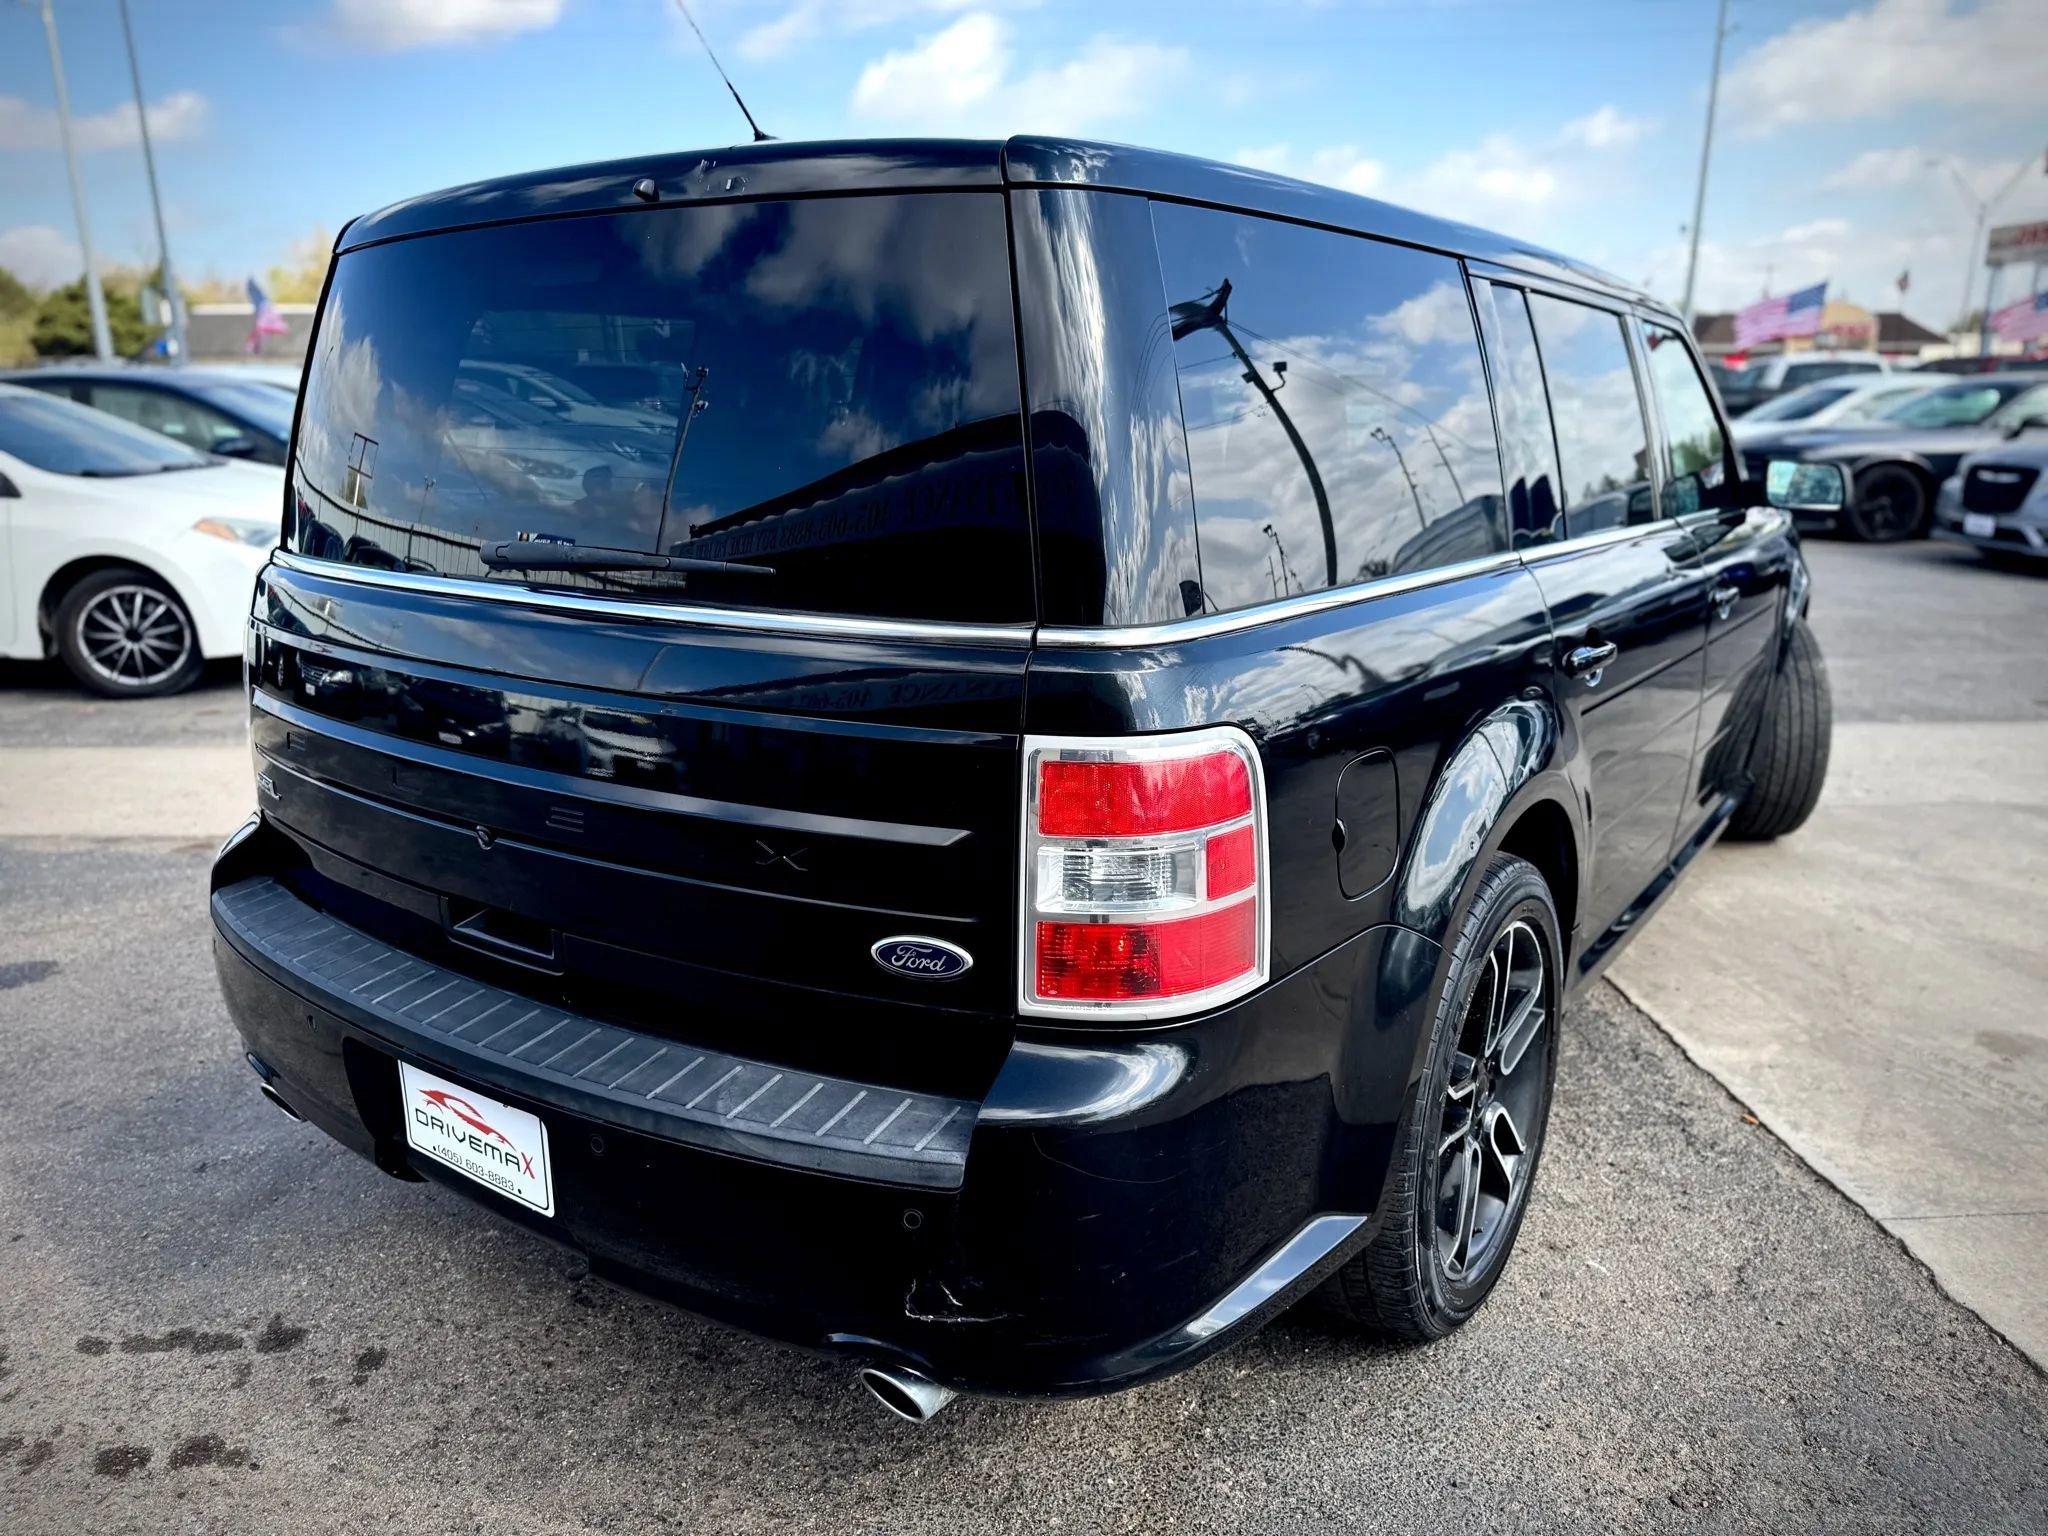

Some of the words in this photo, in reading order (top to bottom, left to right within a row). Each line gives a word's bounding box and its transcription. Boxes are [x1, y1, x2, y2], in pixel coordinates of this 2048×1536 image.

[891, 944, 947, 972] Ford
[415, 1107, 535, 1180] DRIVEMAX
[437, 1144, 463, 1166] (405)
[465, 1158, 515, 1192] 603-8883
